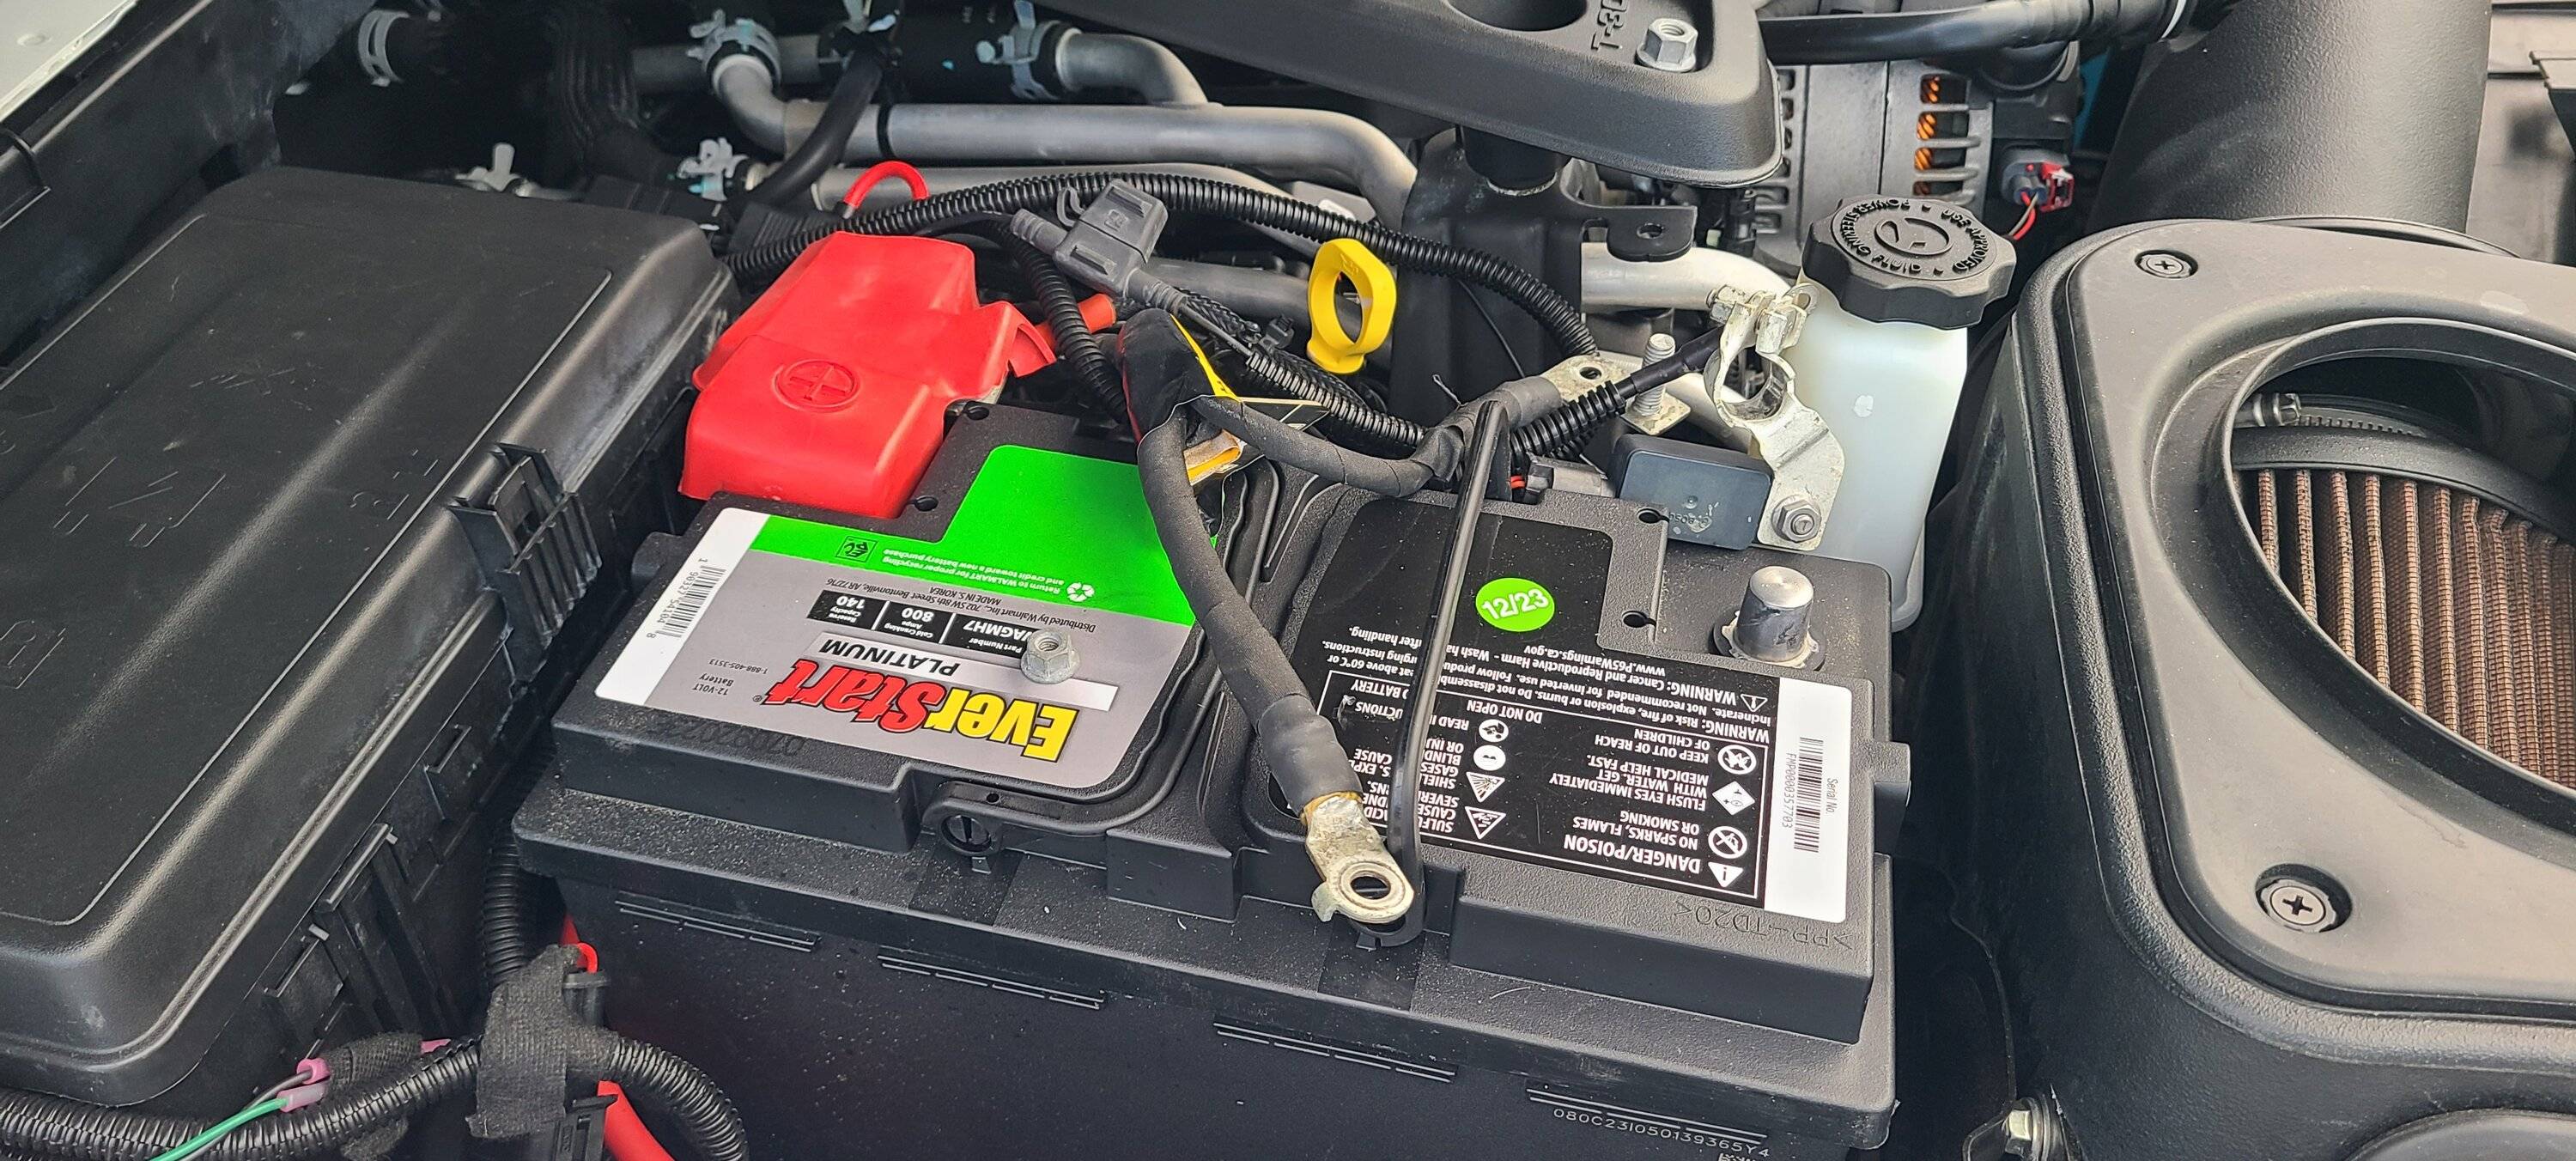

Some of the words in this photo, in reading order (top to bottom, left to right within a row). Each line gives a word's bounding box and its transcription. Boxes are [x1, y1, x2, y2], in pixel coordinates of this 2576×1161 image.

[1870, 254, 1923, 275] FLUID
[882, 556, 924, 570] recycling
[883, 549, 926, 562] purchase
[926, 555, 958, 568] battery
[923, 564, 956, 574] proper
[984, 567, 1018, 577] toward
[678, 571, 698, 595] 90327
[969, 572, 1017, 587] WALMART
[1018, 572, 1046, 582] credit
[1045, 577, 1065, 586] and
[848, 581, 861, 591] AR
[862, 583, 910, 599] Bentonville,
[929, 587, 957, 598] KOREA
[1029, 582, 1060, 594] Return
[836, 595, 866, 609] 140
[910, 593, 937, 604] Street
[937, 597, 951, 607] 8th
[951, 600, 967, 610] SW
[975, 595, 1001, 605] MADE
[1480, 587, 1549, 620] 12/23
[656, 599, 680, 623] 54104
[829, 606, 861, 617] Capacity
[902, 607, 934, 622] 800
[967, 603, 981, 611] 702
[828, 613, 857, 623] Reserve
[1000, 608, 1037, 623] Walmart
[1037, 613, 1049, 625] by
[884, 623, 915, 636] Cranking
[902, 620, 922, 630] Amps
[1049, 616, 1096, 633] Distributed
[915, 629, 933, 638] Cold
[1348, 626, 1398, 646] handling.
[969, 637, 1003, 651] Number
[1002, 642, 1023, 653] Part
[1322, 641, 1386, 660] instructions.
[817, 639, 960, 677] PLATINUM
[1327, 654, 1340, 663] or
[1460, 646, 1490, 663] Wash
[1501, 653, 1531, 669] Harm
[1523, 645, 1666, 677] www.P65Warnings.ca.gov
[708, 658, 769, 675] 1-888-405-3513
[1340, 656, 1365, 670] 60°C
[1365, 661, 1398, 675] above
[1443, 661, 1476, 675] produ
[1532, 658, 1604, 682] Reproductive
[699, 673, 733, 687] Battery
[1475, 667, 1512, 684] Follow
[1516, 673, 1539, 685] use.
[1604, 671, 1626, 684] and
[1626, 674, 1665, 691] Cancer
[692, 684, 729, 696] 12-VOLT
[1350, 679, 1401, 699] BATTERY
[1496, 684, 1516, 696] not
[1516, 689, 1534, 699] Do
[1539, 678, 1585, 696] inverted
[1585, 685, 1602, 698] for
[1666, 680, 1736, 706] WARNING:
[1534, 690, 1569, 706] burns.
[1569, 696, 1583, 707] or
[1583, 697, 1637, 714] explosion
[1607, 689, 1685, 711] recommended
[1466, 699, 1498, 716] OPEN
[1498, 706, 1524, 721] NOT
[1637, 708, 1661, 722] fire,
[1686, 702, 1707, 716] Not
[1437, 716, 1470, 731] READ
[1525, 709, 1542, 725] DO
[1661, 713, 1674, 723] of
[1674, 714, 1698, 728] Risk
[1712, 707, 1771, 726] incinerate.
[1633, 728, 1692, 747] CHILDREN
[1702, 719, 1770, 744] WARNING:
[1425, 738, 1445, 751] INJ
[1446, 740, 1464, 754] OR
[1594, 734, 1633, 751] REACH
[1634, 742, 1650, 754] OF
[1693, 739, 1710, 751] OF
[1353, 749, 1392, 765] CAUSE
[1422, 749, 1461, 766] BLIND
[1652, 745, 1678, 759] OUT
[1679, 749, 1709, 764] KEEP
[1420, 762, 1458, 778] GASES
[1587, 754, 1618, 771] FAST.
[1619, 761, 1652, 776] HELP
[1419, 773, 1456, 790] SHIEL
[1595, 768, 1619, 783] GET
[1623, 773, 1668, 793] WATER.
[1652, 766, 1709, 785] MEDICAL
[1549, 772, 1632, 799] IMMEDIATELY
[1673, 783, 1707, 799] WITH
[1826, 778, 1838, 800] Serial
[1418, 790, 1460, 808] SEVER
[1635, 788, 1664, 805] EYES
[1666, 793, 1706, 811] FLUSH
[1418, 803, 1456, 821] CAUSE
[1826, 801, 1838, 814] No.
[1572, 816, 1623, 836] FLAMES
[1619, 810, 1680, 831] SMOKING
[1681, 821, 1699, 835] OR
[1624, 824, 1676, 846] SPARKS,
[1678, 836, 1698, 850] NO
[1563, 834, 1700, 874] DANGER/POISON
